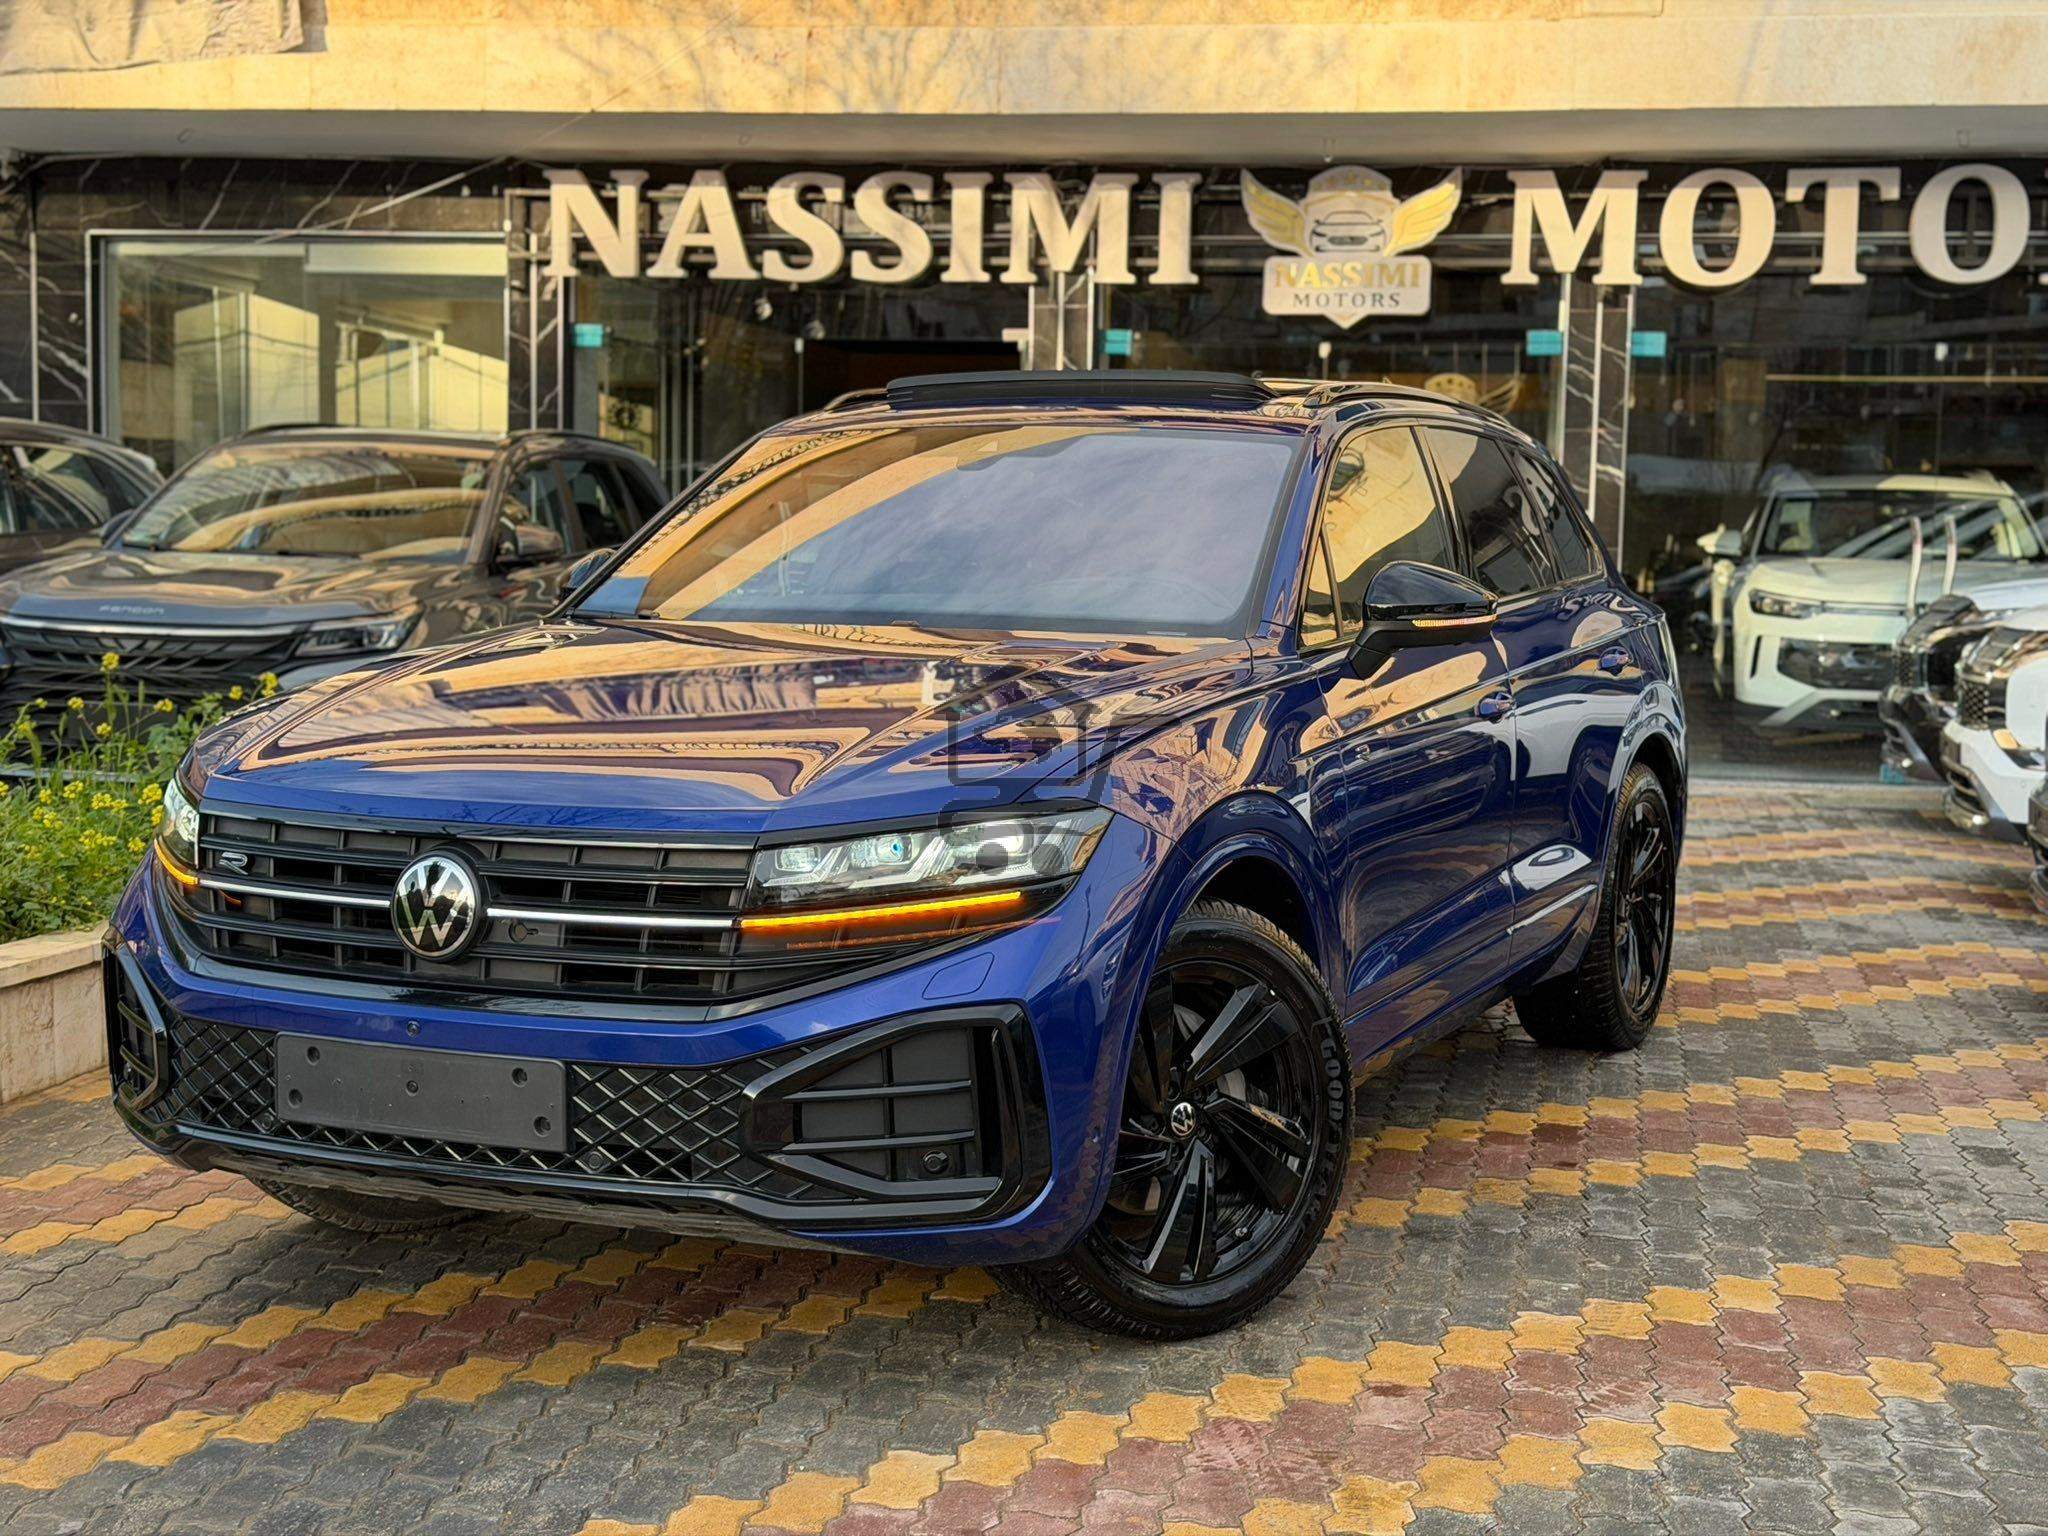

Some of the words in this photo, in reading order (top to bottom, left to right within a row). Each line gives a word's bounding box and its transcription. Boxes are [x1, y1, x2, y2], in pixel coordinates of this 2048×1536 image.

[543, 169, 1202, 284] NASSIMI
[1501, 163, 2048, 286] MOTO
[1274, 262, 1422, 289] NASSIMI
[1293, 293, 1400, 309] MOTORS
[219, 851, 248, 876] R
